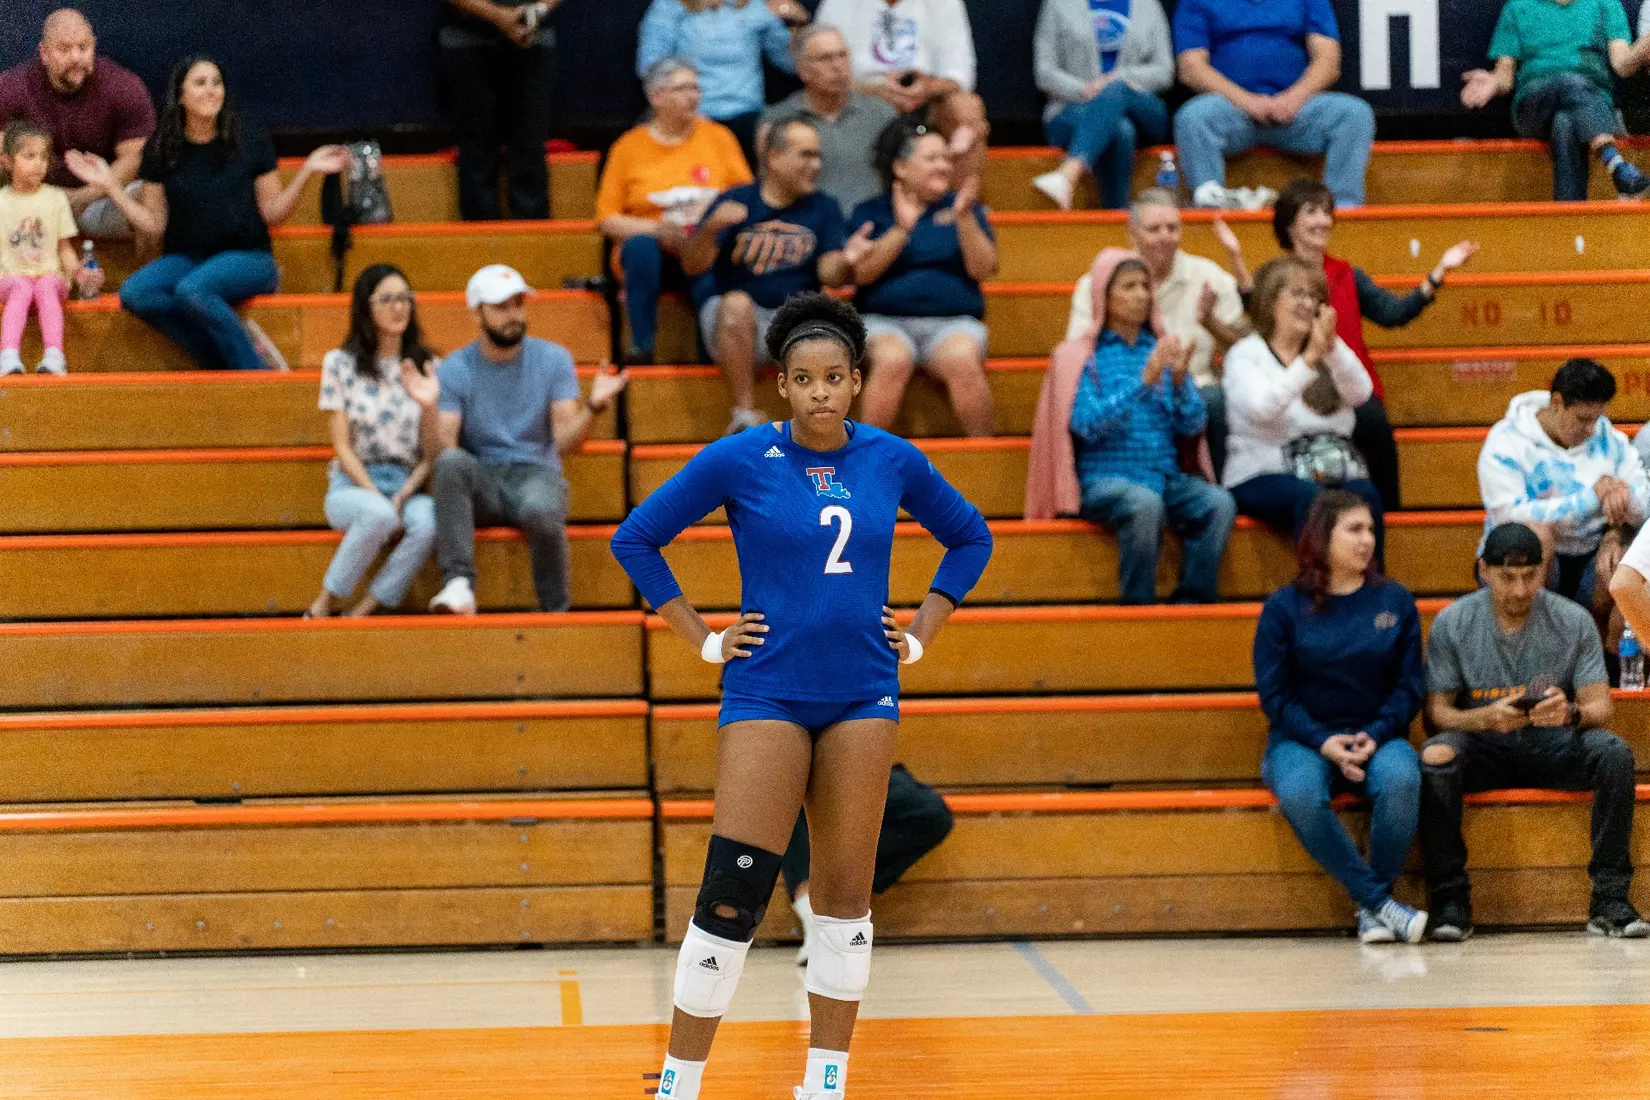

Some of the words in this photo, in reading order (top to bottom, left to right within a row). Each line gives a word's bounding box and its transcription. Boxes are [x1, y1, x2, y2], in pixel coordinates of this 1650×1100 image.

[820, 505, 853, 574] 2
[849, 939, 867, 947] adidas
[699, 961, 720, 971] adidas
